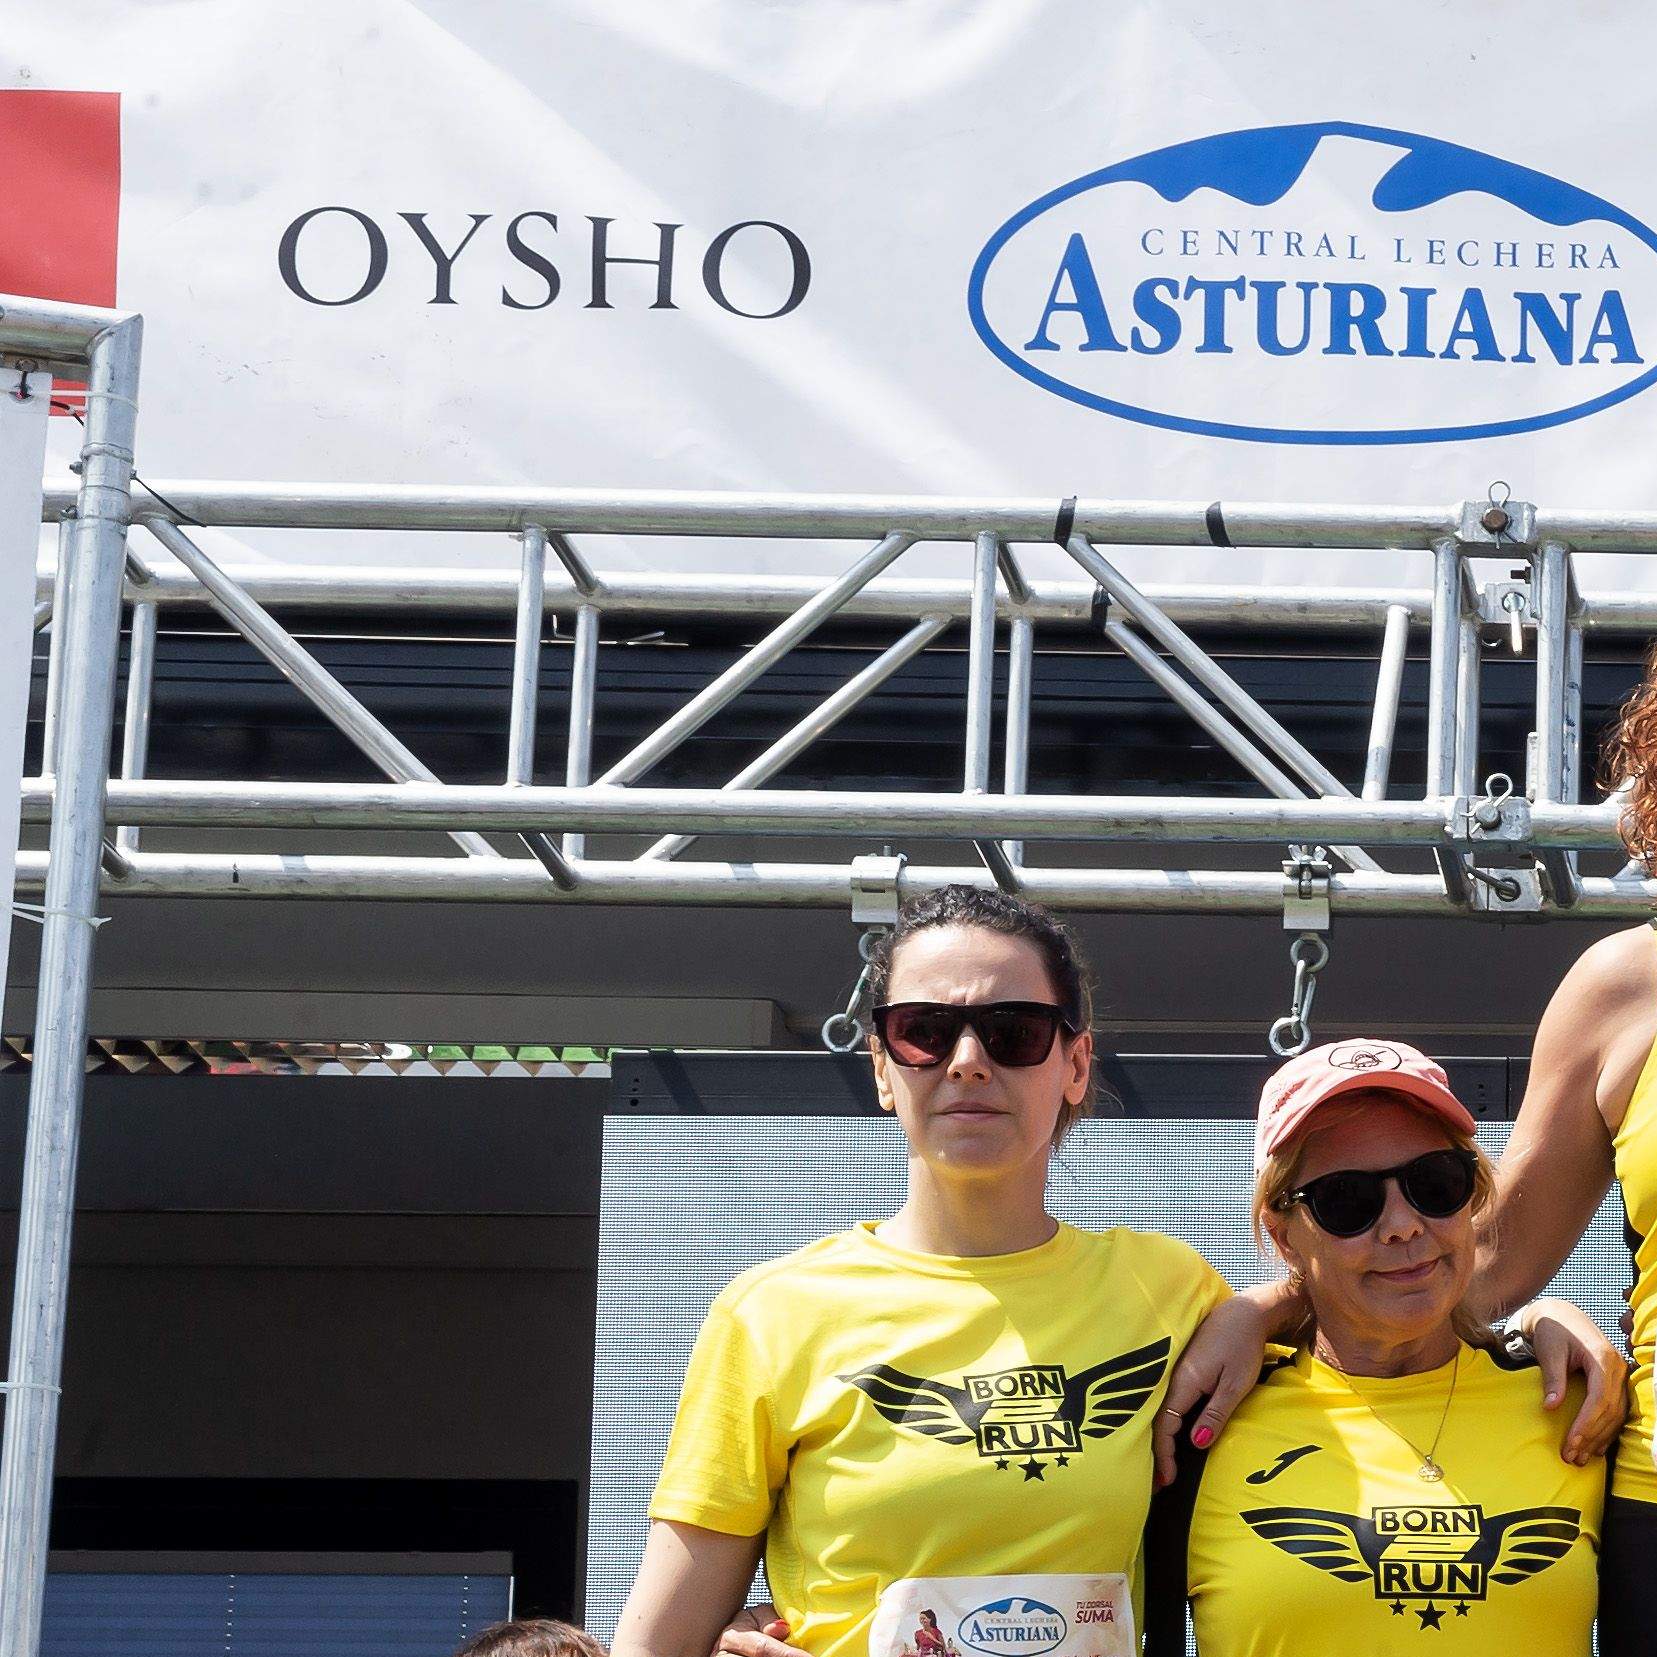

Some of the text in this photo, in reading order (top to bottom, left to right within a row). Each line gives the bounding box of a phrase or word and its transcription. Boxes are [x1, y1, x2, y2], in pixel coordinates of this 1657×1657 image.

[278, 206, 812, 319] OYSHO
[1141, 228, 1622, 270] CENTRAL LECHERA
[1024, 232, 1644, 366] ASTURIANA
[973, 1372, 1061, 1400] BORN
[983, 1422, 1076, 1453] RUN
[1378, 1507, 1476, 1535] BORN
[1381, 1563, 1482, 1595] RUN
[968, 1620, 1060, 1643] ASTURIANA
[1075, 1609, 1114, 1624] SUMA
